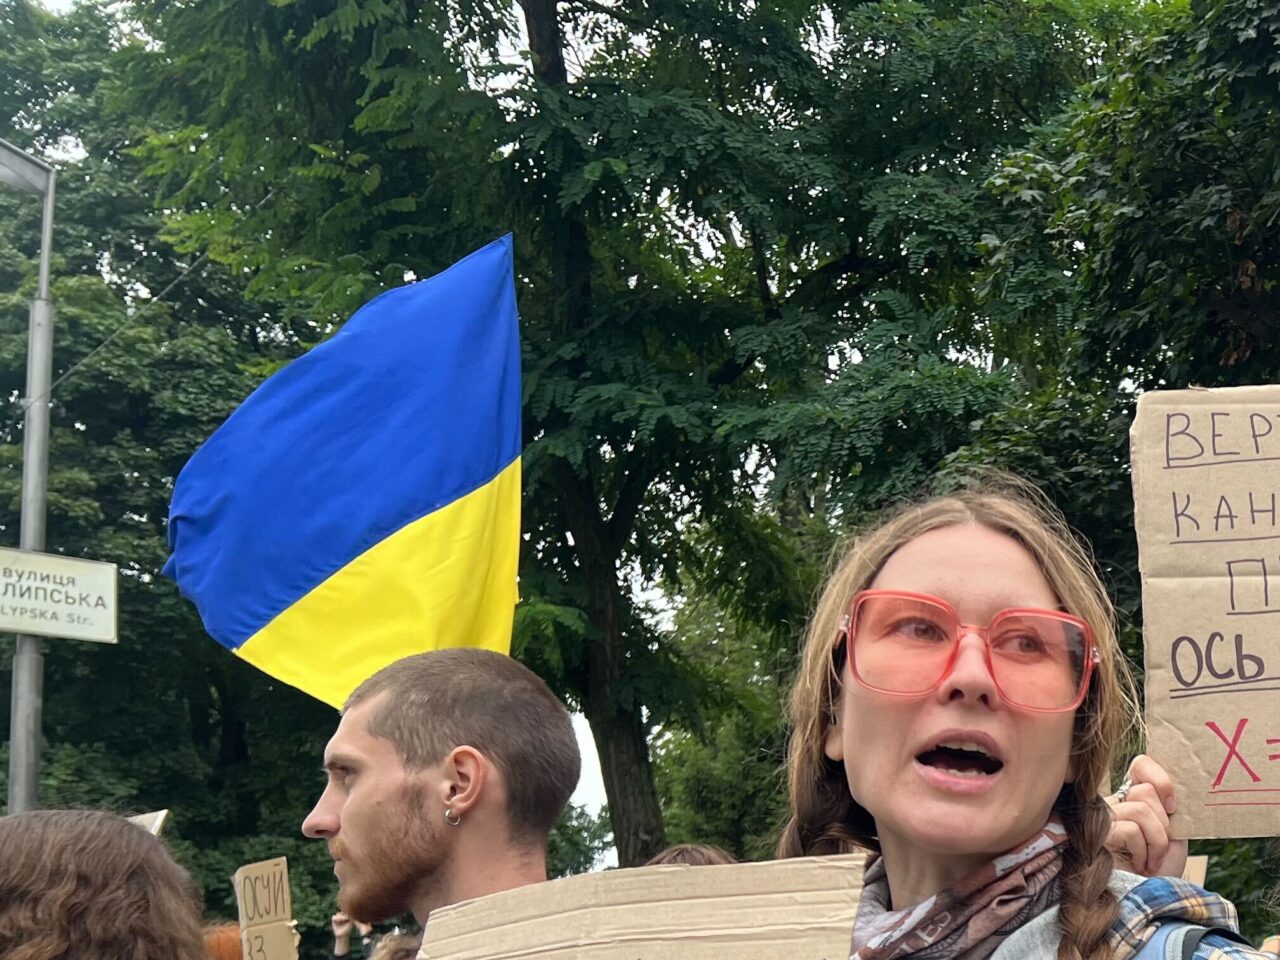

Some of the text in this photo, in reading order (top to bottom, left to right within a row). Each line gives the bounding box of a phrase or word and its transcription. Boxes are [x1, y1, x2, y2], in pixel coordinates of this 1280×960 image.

[2, 582, 107, 609] ЛИПСЬКА
[1, 604, 59, 621] LYPSKA
[1170, 632, 1266, 688] ОСЬ
